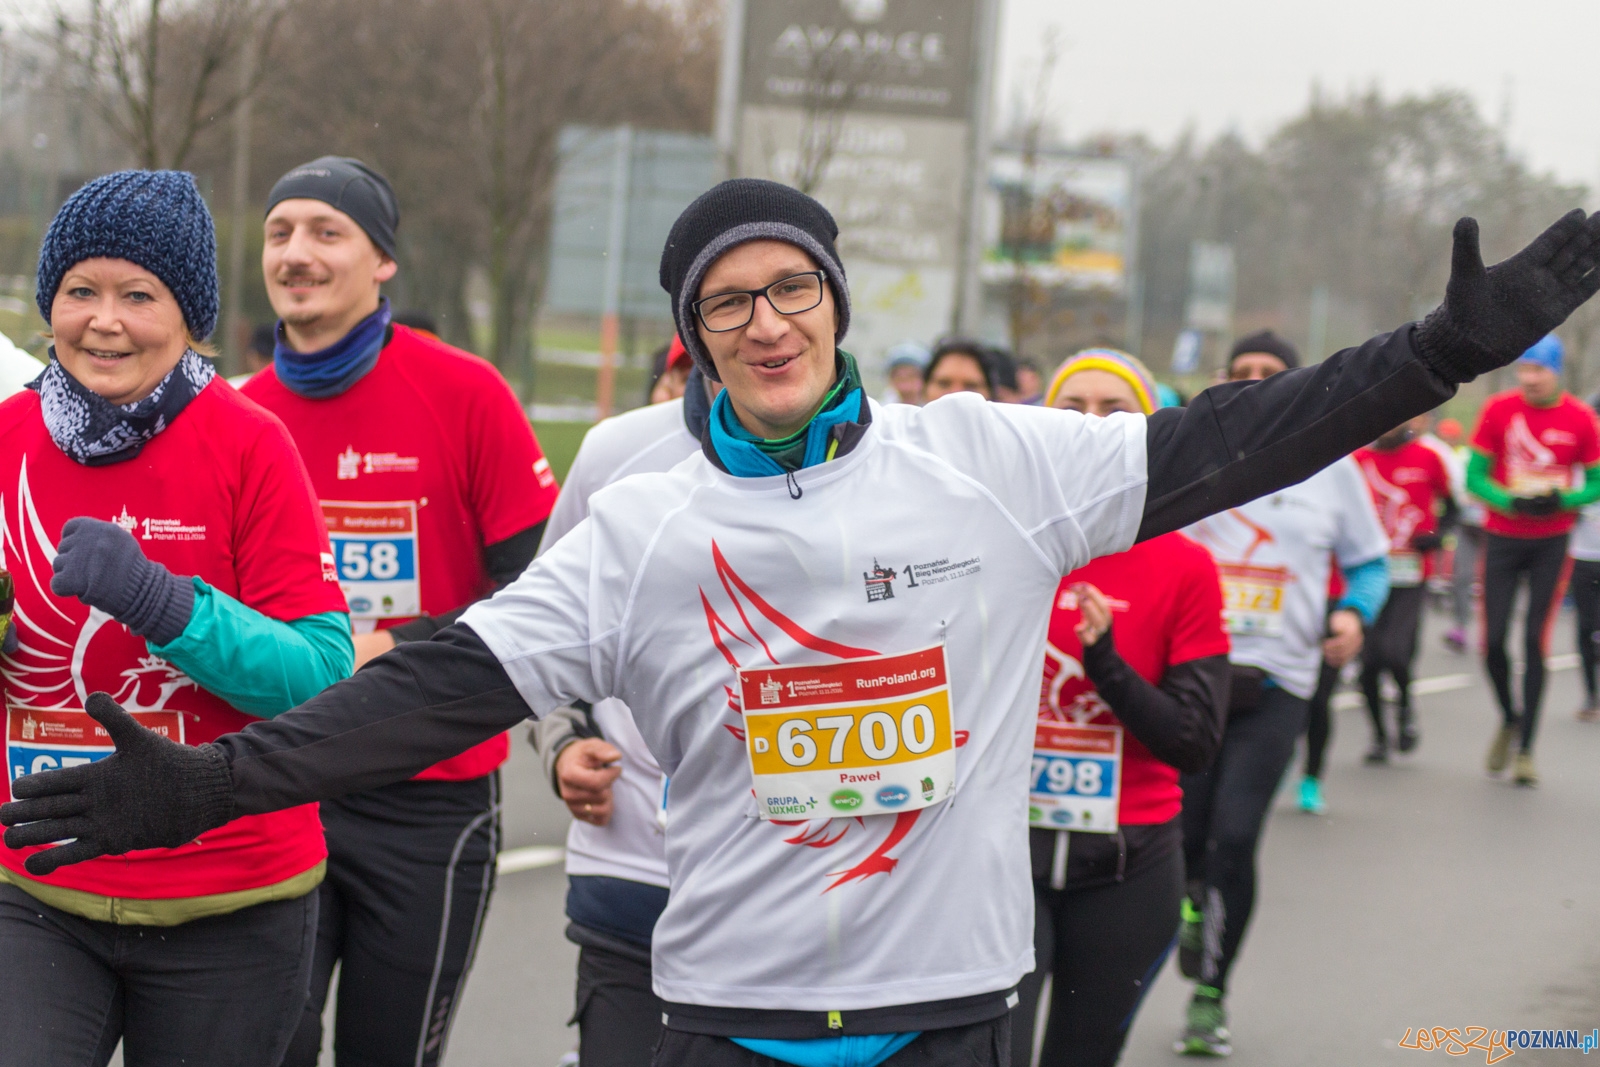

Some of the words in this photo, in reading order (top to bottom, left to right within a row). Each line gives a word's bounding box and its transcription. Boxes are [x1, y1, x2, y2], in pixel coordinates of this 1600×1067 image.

[141, 517, 153, 540] 1
[903, 565, 919, 588] 1
[914, 557, 949, 570] Poznański
[915, 570, 932, 578] Bieg
[932, 556, 981, 574] Niepodległości
[856, 667, 936, 689] RunPoland.org
[786, 681, 798, 698] 1
[754, 736, 770, 754] D
[777, 704, 936, 767] 6700
[840, 771, 881, 783] Paweł
[767, 796, 799, 806] GRUPA
[768, 805, 807, 815] LUXMED
